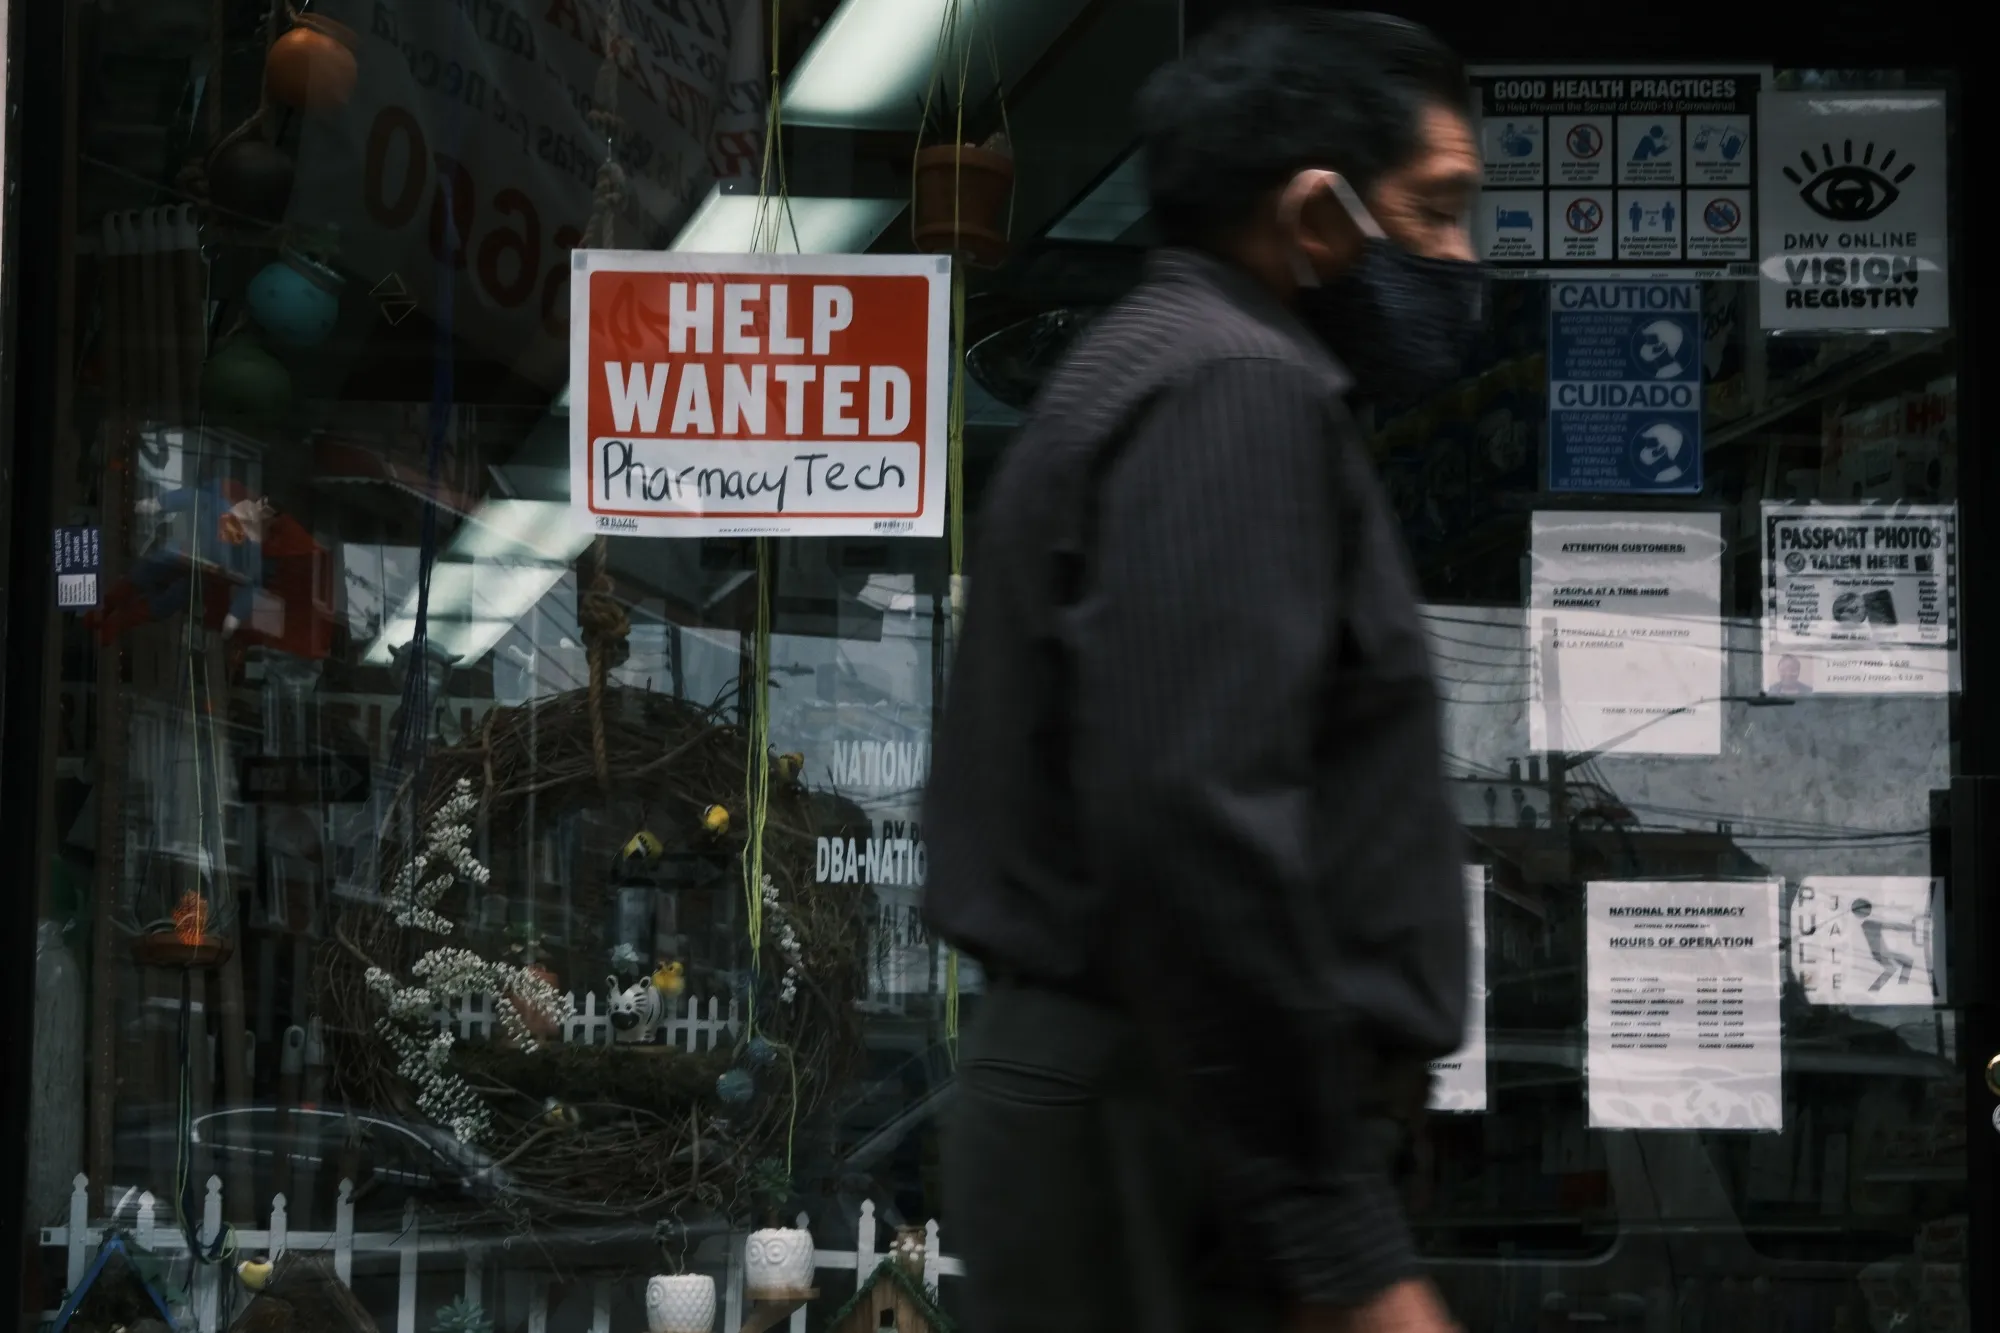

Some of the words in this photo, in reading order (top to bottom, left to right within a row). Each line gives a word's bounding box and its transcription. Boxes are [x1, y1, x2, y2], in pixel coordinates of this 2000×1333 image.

[1494, 81, 1546, 99] GOOD
[1553, 80, 1624, 98] HEALTH
[1630, 80, 1736, 98] PRACTICES
[1507, 103, 1527, 112] Help
[1631, 101, 1673, 111] COVID-19
[1784, 233, 1829, 249] DMV
[1838, 232, 1917, 248] ONLINE
[1785, 256, 1918, 286] VISION
[1559, 285, 1691, 309] CAUTION
[1785, 287, 1919, 308] REGISTRY
[668, 282, 853, 356] HELP
[604, 361, 911, 437] WANTED
[1558, 384, 1692, 408] CUIDADO
[1572, 456, 1616, 465] INTERVALO
[602, 441, 788, 513] Pharmacy
[794, 453, 906, 498] Tech
[1781, 527, 1867, 549] PASSPORT
[1874, 526, 1941, 549] PHOTOS
[1562, 543, 1618, 553] ATTENTION
[1810, 554, 1862, 570] TAKEN
[1867, 554, 1908, 569] HERE
[1560, 587, 1593, 596] PEOPLE
[1595, 587, 1607, 596] AT
[1609, 587, 1615, 596] A
[1617, 587, 1638, 596] TIME
[1641, 588, 1669, 596] INSIDE
[1553, 599, 1600, 608] PHARMACY
[1561, 629, 1605, 637] PERSONAS
[1630, 629, 1646, 637] VEZ
[1567, 641, 1578, 649] LA
[1580, 641, 1624, 649] FARMACIA
[833, 740, 931, 787] NATIONA
[1609, 907, 1663, 917] NATIONAL
[1667, 907, 1681, 917] RX
[1685, 907, 1744, 916] PHARMACY
[1610, 937, 1655, 947] HOURS
[1658, 937, 1675, 947] OF
[1679, 936, 1754, 947] OPERATION
[1830, 894, 1843, 991] JALE
